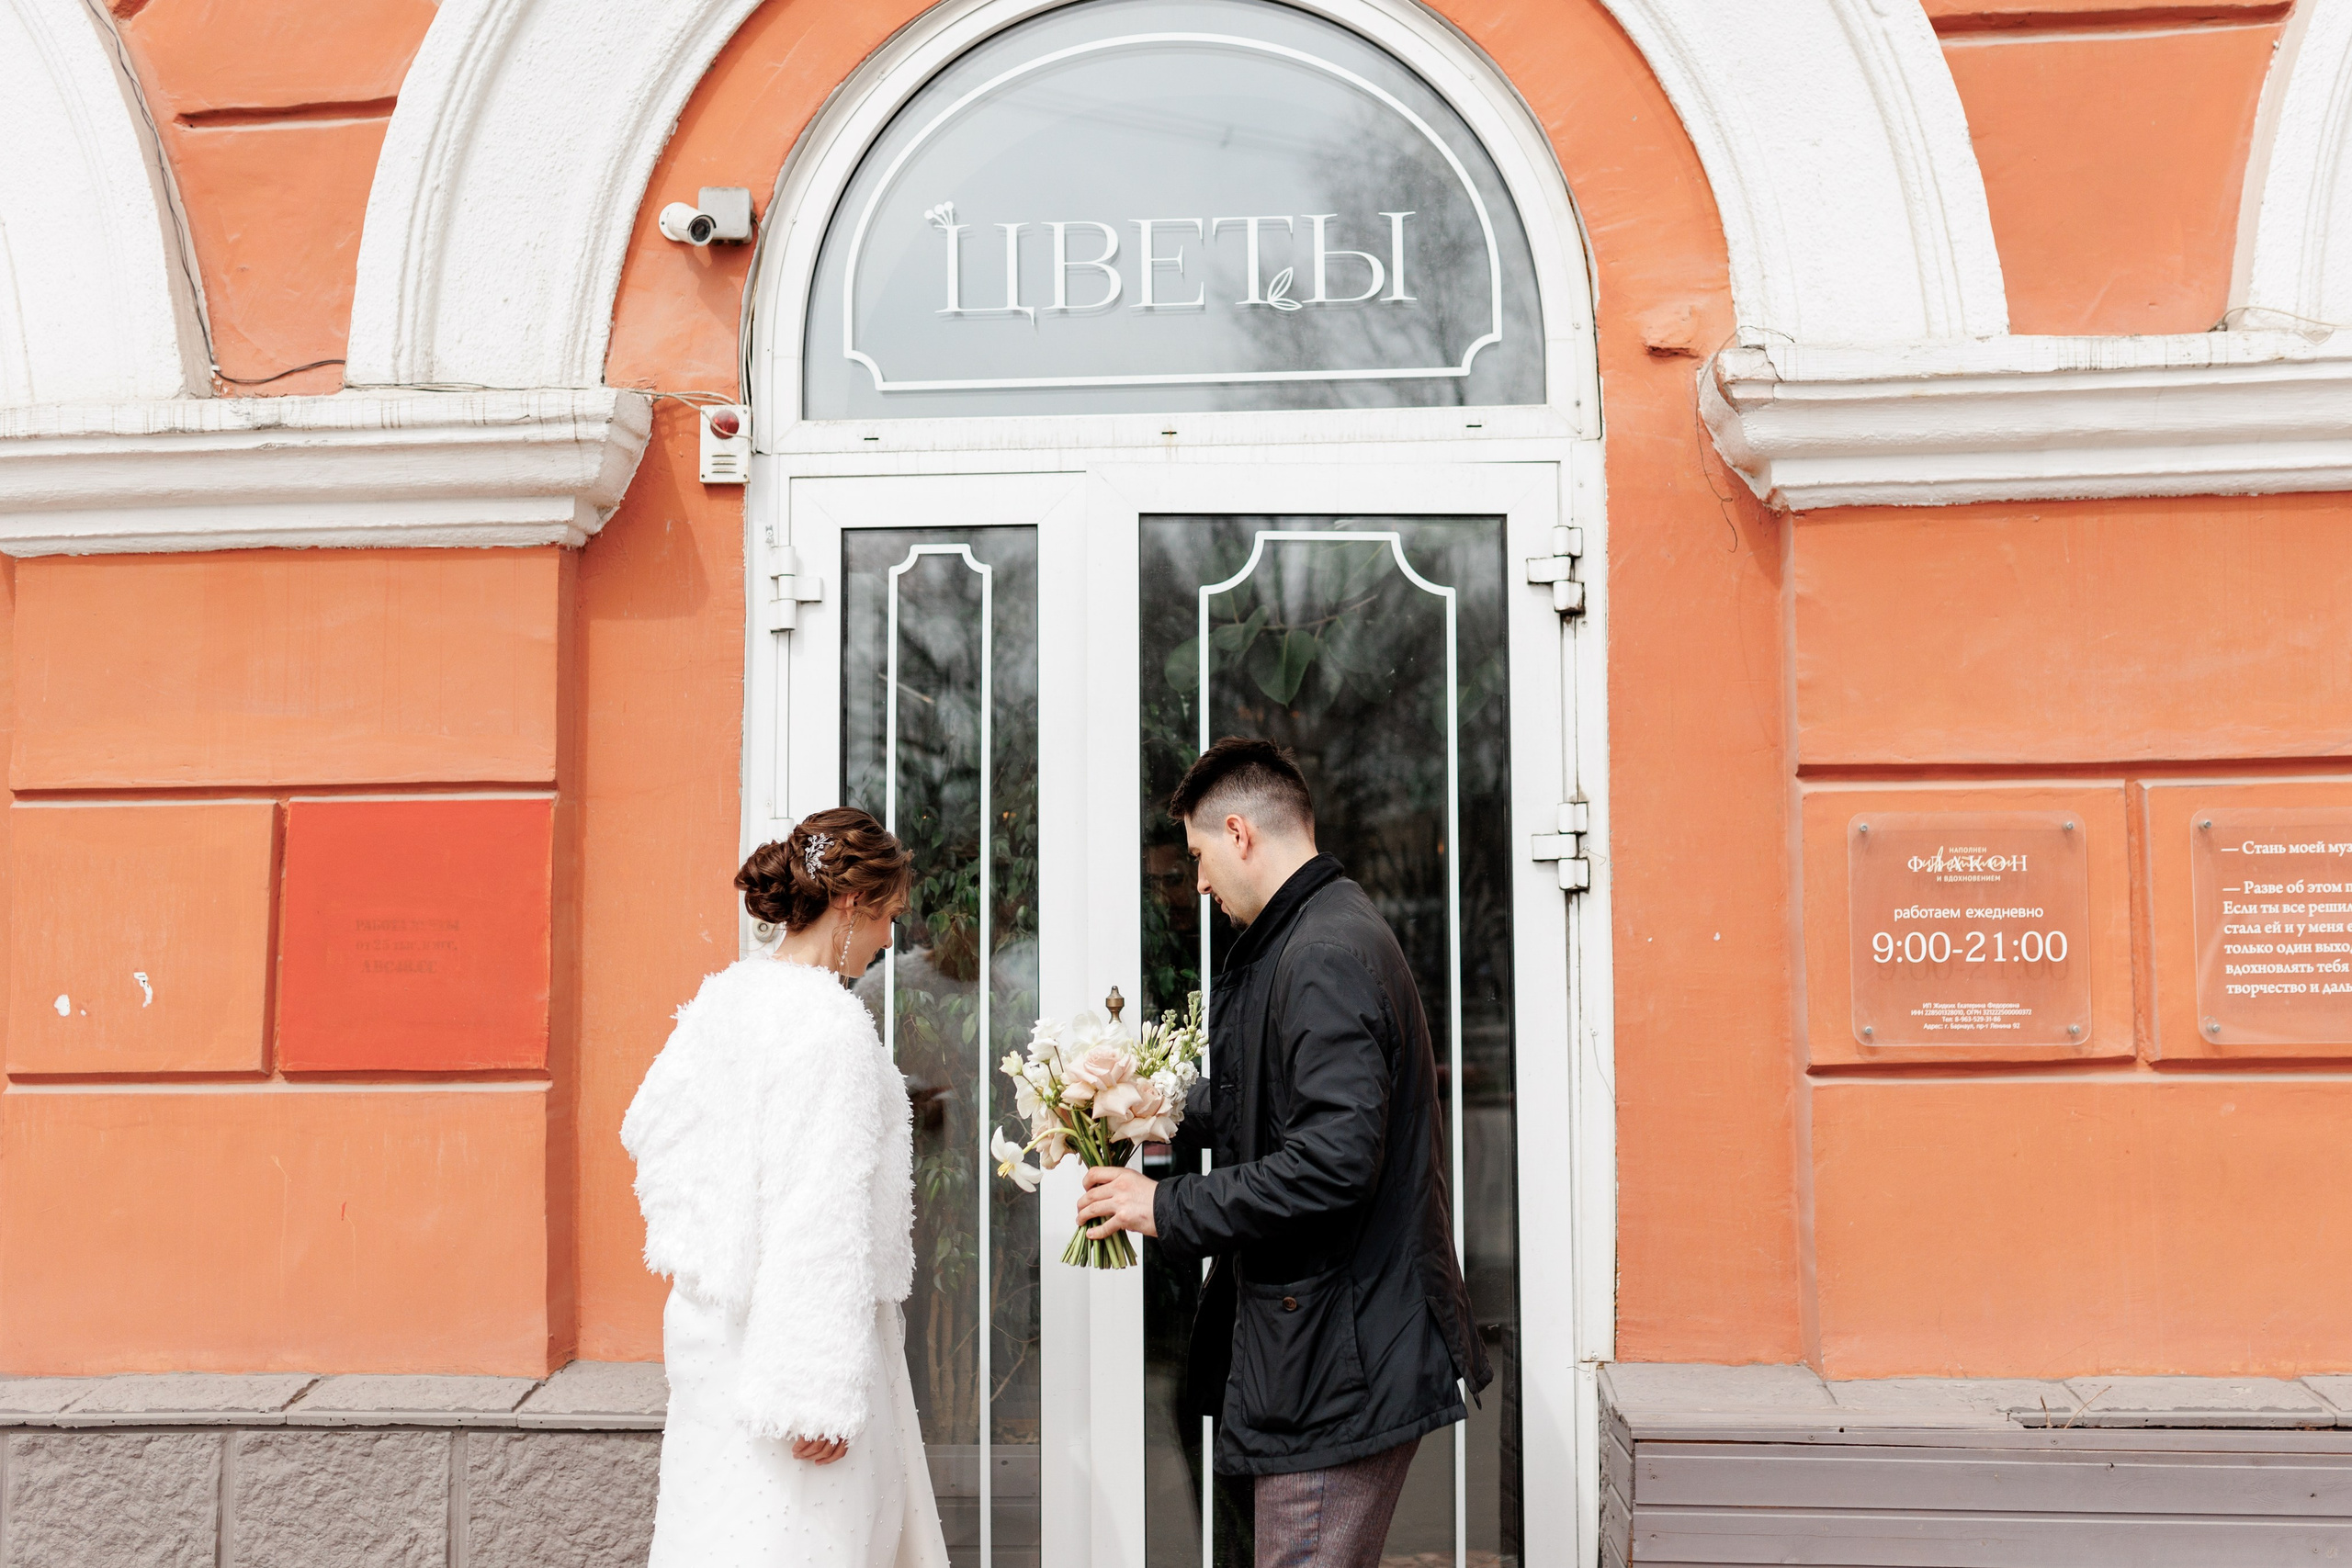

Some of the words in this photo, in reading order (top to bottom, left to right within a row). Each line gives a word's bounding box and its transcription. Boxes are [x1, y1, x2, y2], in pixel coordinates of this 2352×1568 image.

[933, 211, 1418, 326] ЦВЕТЫ
[1949, 846, 1987, 854] НАПОЛНЕН
[2242, 840, 2287, 855] Стань
[2289, 840, 2325, 854] моей
[1943, 874, 2001, 883] ВДОХНОВЕНИЕМ
[2244, 880, 2284, 895] Разве
[2286, 879, 2305, 894] об
[2307, 883, 2343, 893] этом
[1894, 905, 1961, 922] работаем
[1965, 907, 2044, 919] ежедневно
[2222, 900, 2258, 915] Если
[2260, 904, 2280, 914] ты
[2282, 903, 2306, 914] все
[2223, 923, 2262, 935] стала
[2264, 920, 2282, 933] ей
[2284, 923, 2294, 933] и
[2296, 923, 2306, 938] у
[2307, 922, 2344, 933] меня
[1871, 931, 2068, 964] 9:00-21:00
[2223, 943, 2274, 954] только
[2276, 943, 2312, 955] один
[2315, 942, 2352, 955] выхо
[2225, 964, 2315, 976] вдохновлять
[2316, 958, 2350, 974] тебя
[2226, 983, 2307, 998] творчество
[2309, 983, 2320, 993] и
